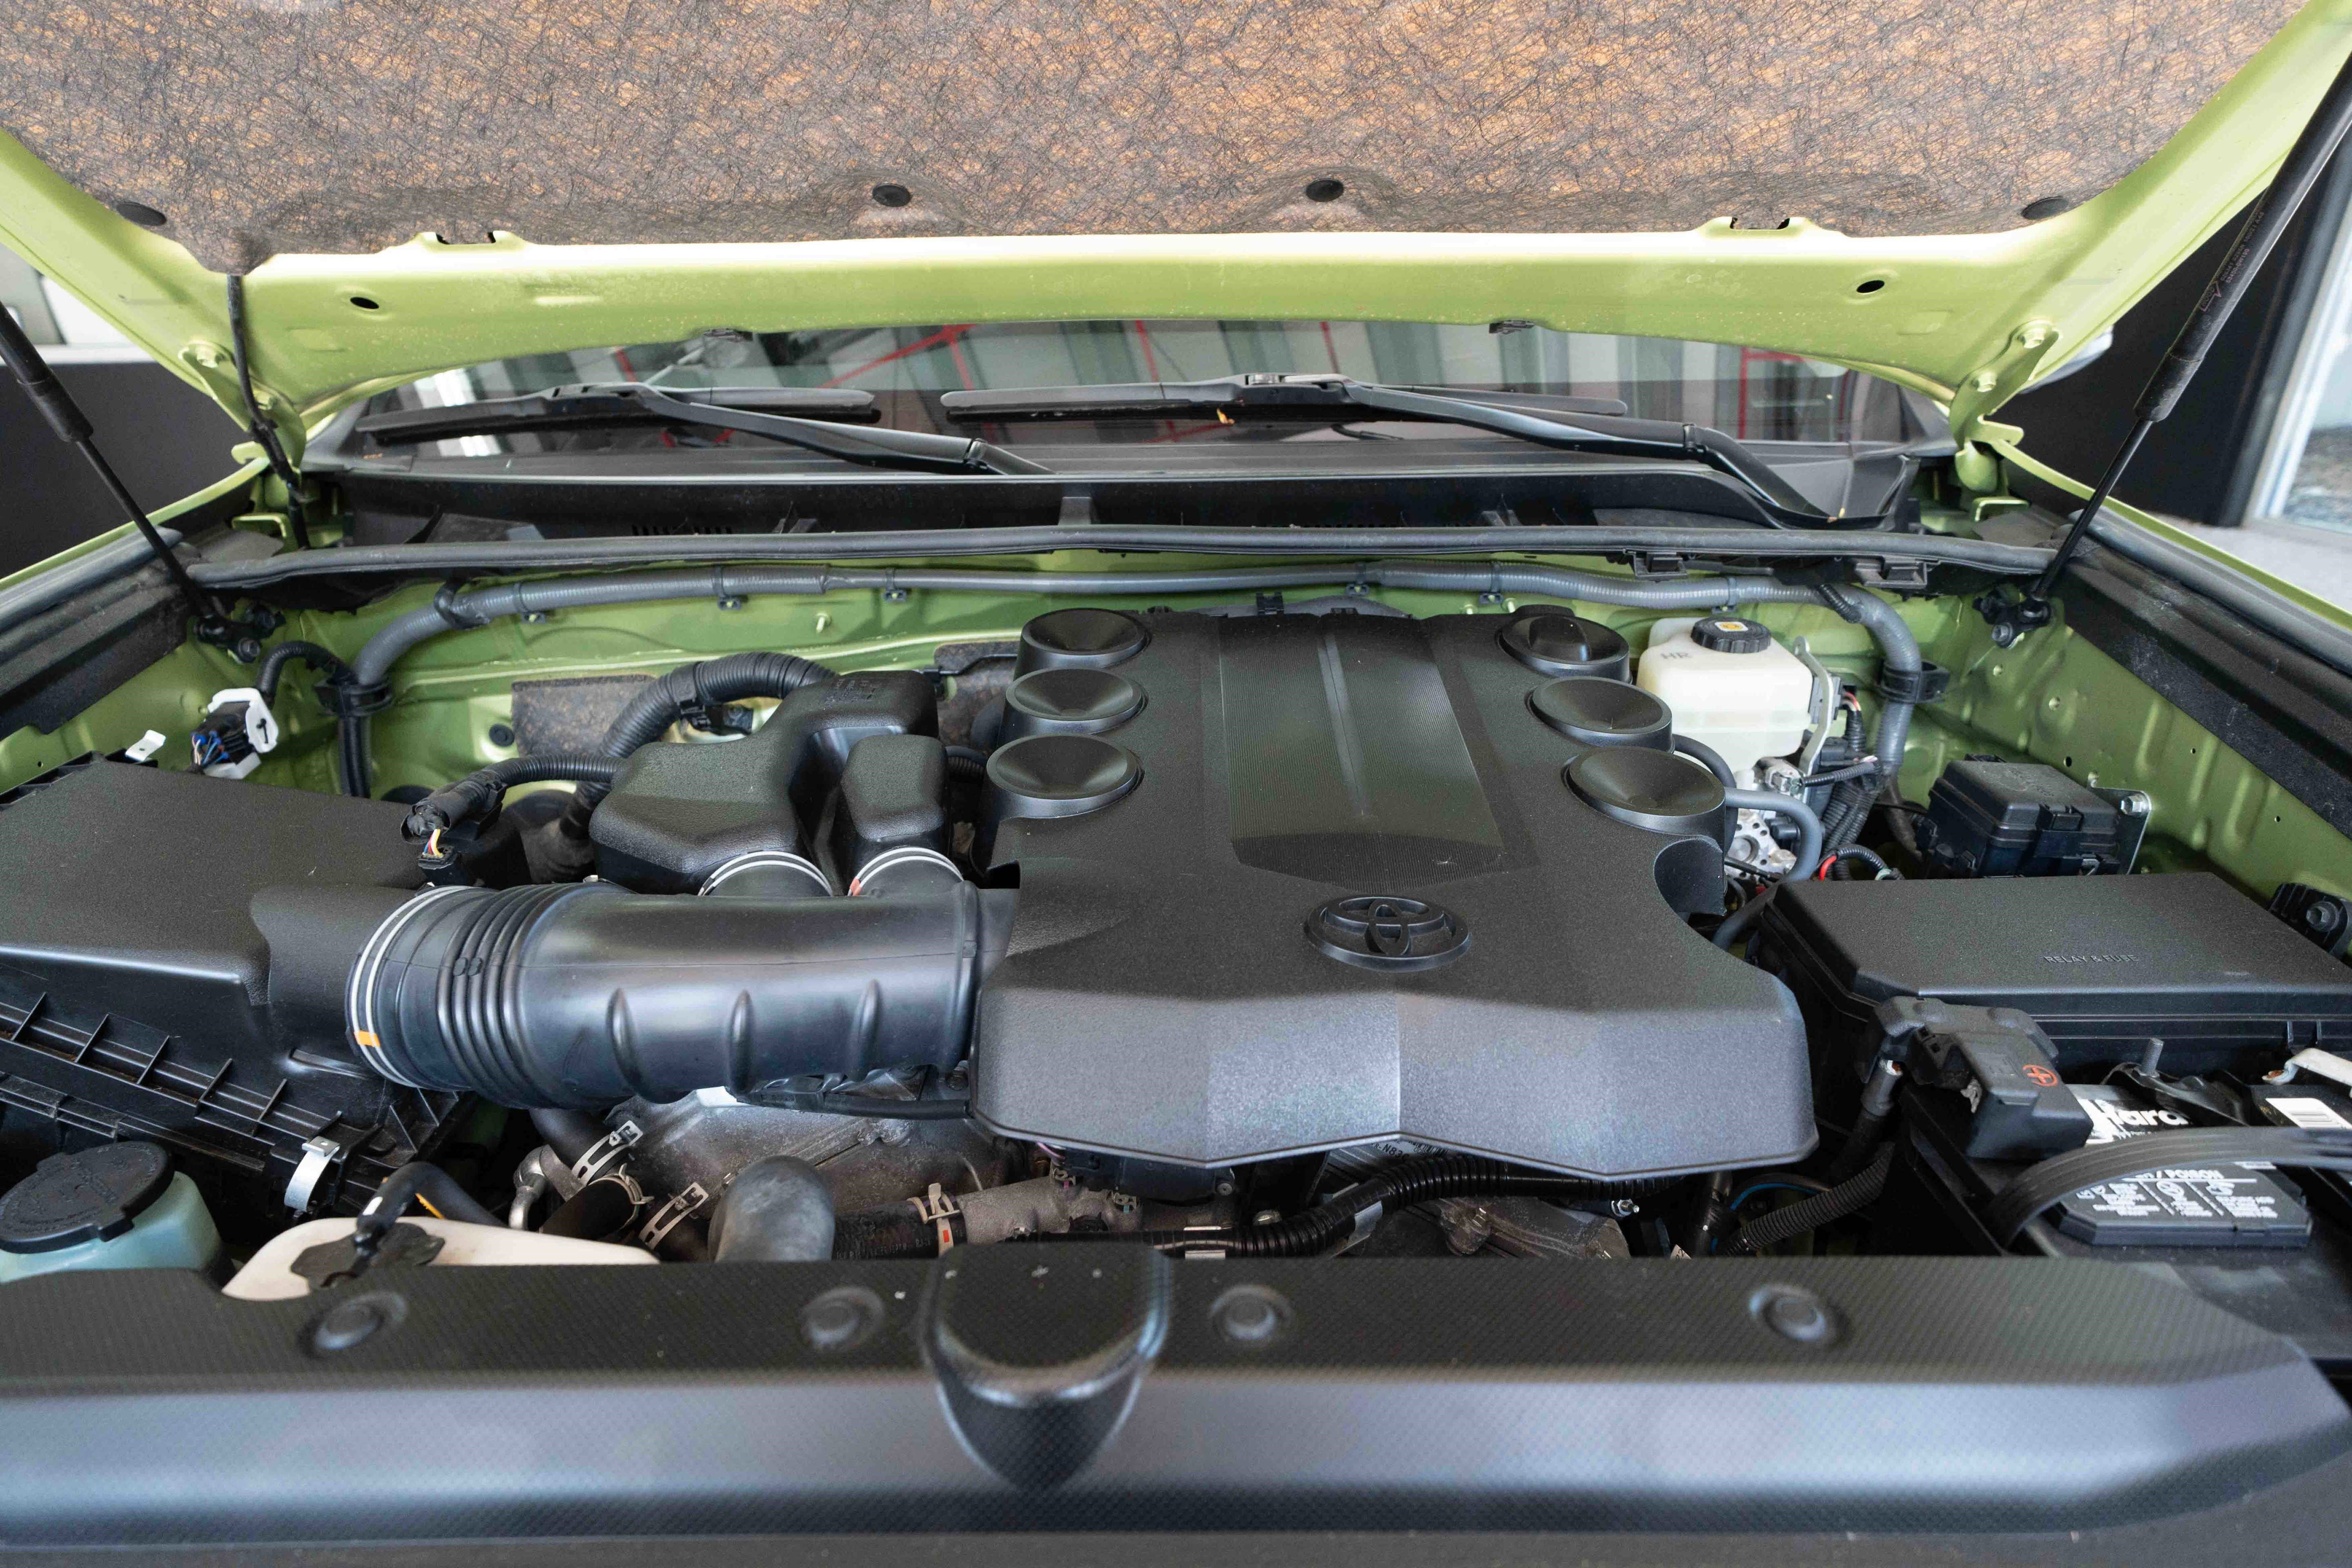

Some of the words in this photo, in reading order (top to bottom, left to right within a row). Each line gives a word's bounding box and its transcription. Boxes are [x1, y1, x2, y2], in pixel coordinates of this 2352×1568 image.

[2043, 956, 2087, 964] RELAY
[2102, 954, 2139, 962] FUSE
[2164, 1169, 2225, 1179] POISON
